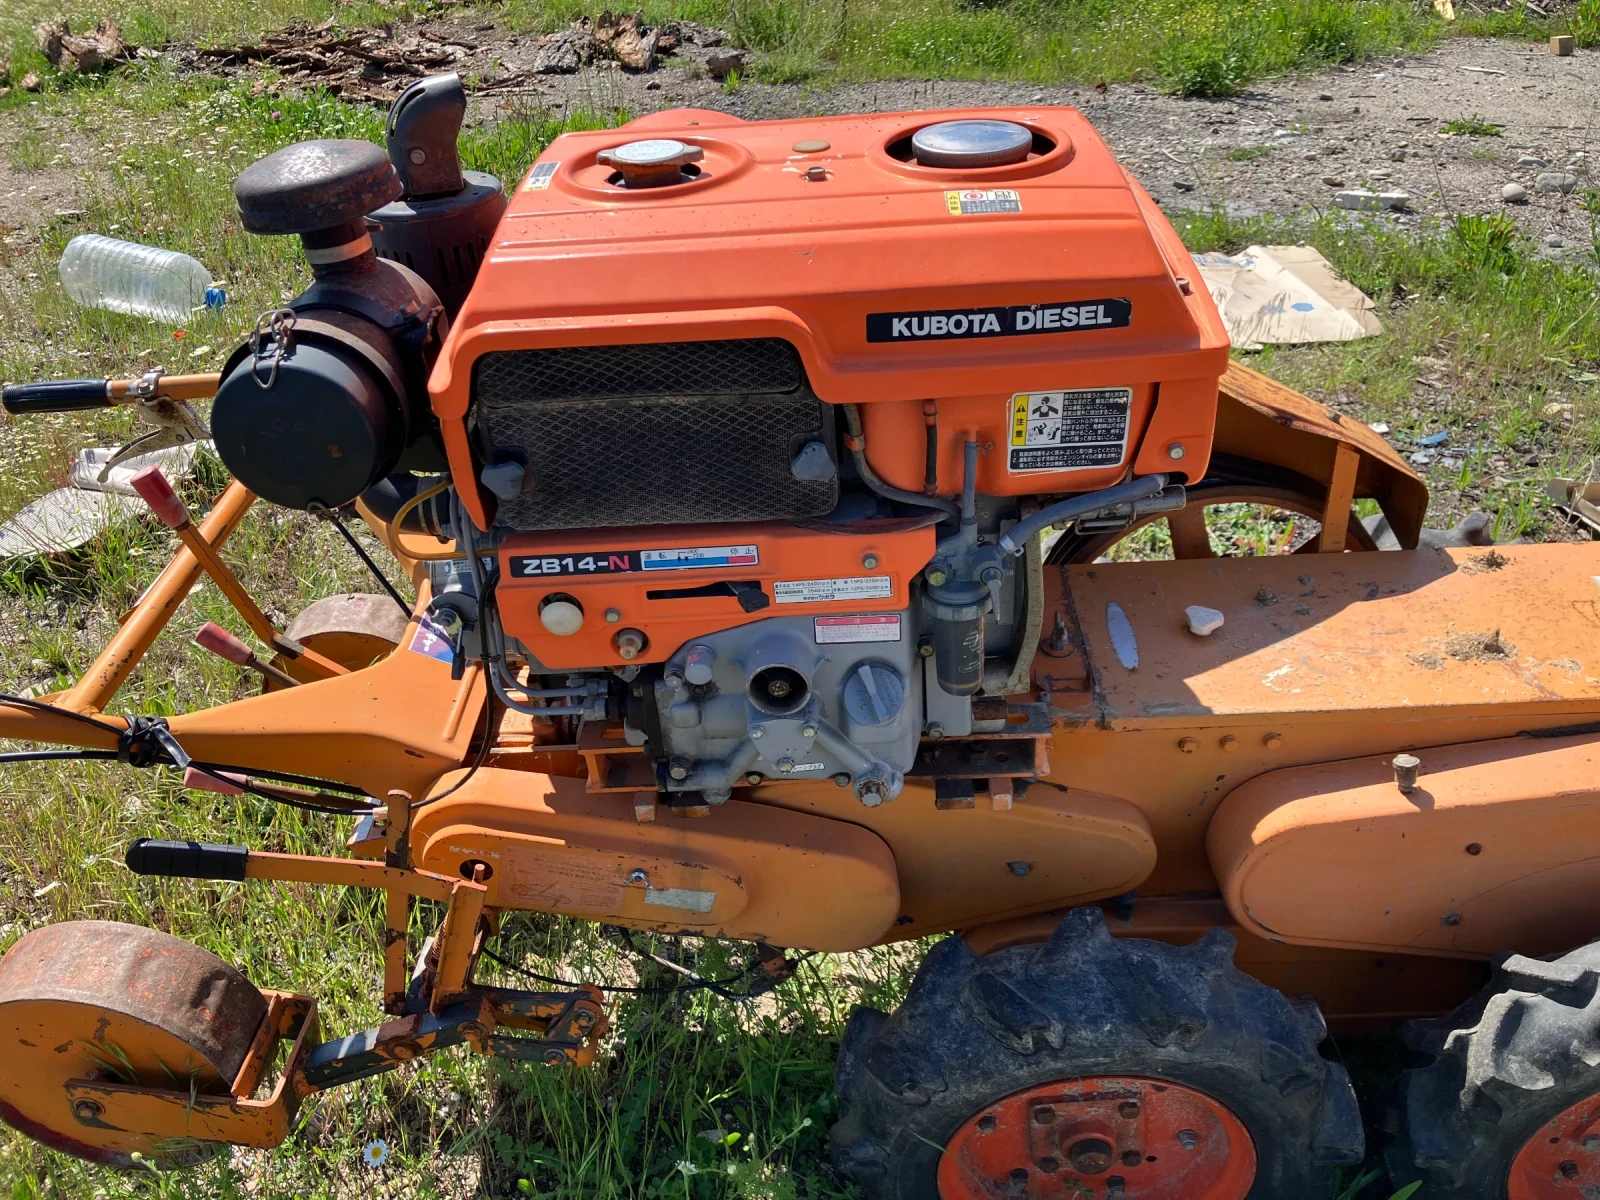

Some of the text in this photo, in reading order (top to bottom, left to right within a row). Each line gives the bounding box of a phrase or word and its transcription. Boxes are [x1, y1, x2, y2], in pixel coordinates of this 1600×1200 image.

[892, 304, 1113, 337] KUBOTA DIESEL
[1014, 418, 1025, 438] 注意
[522, 555, 630, 575] ZB14-N
